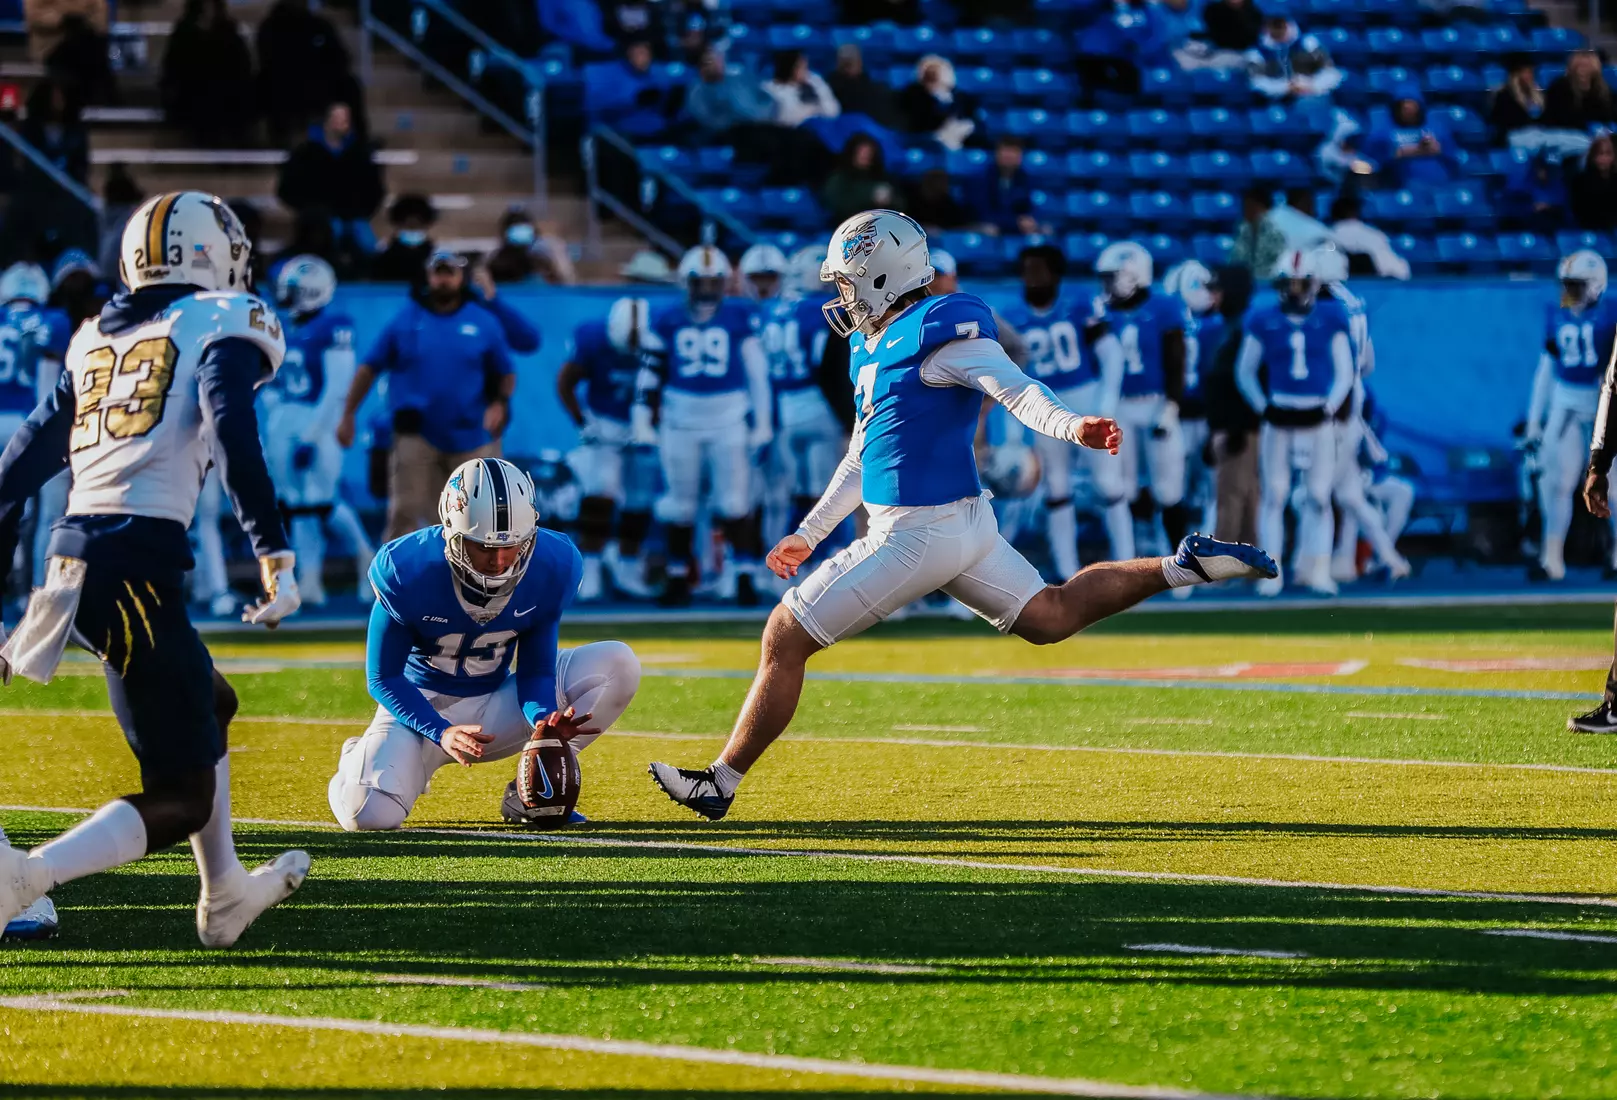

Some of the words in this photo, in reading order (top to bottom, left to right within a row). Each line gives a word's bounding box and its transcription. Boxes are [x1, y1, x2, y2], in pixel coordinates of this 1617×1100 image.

[673, 328, 730, 378] 99
[1023, 321, 1081, 377] 20
[1288, 329, 1309, 380] 1
[1557, 321, 1599, 368] 91
[71, 336, 180, 453] 23
[428, 629, 519, 677] 13
